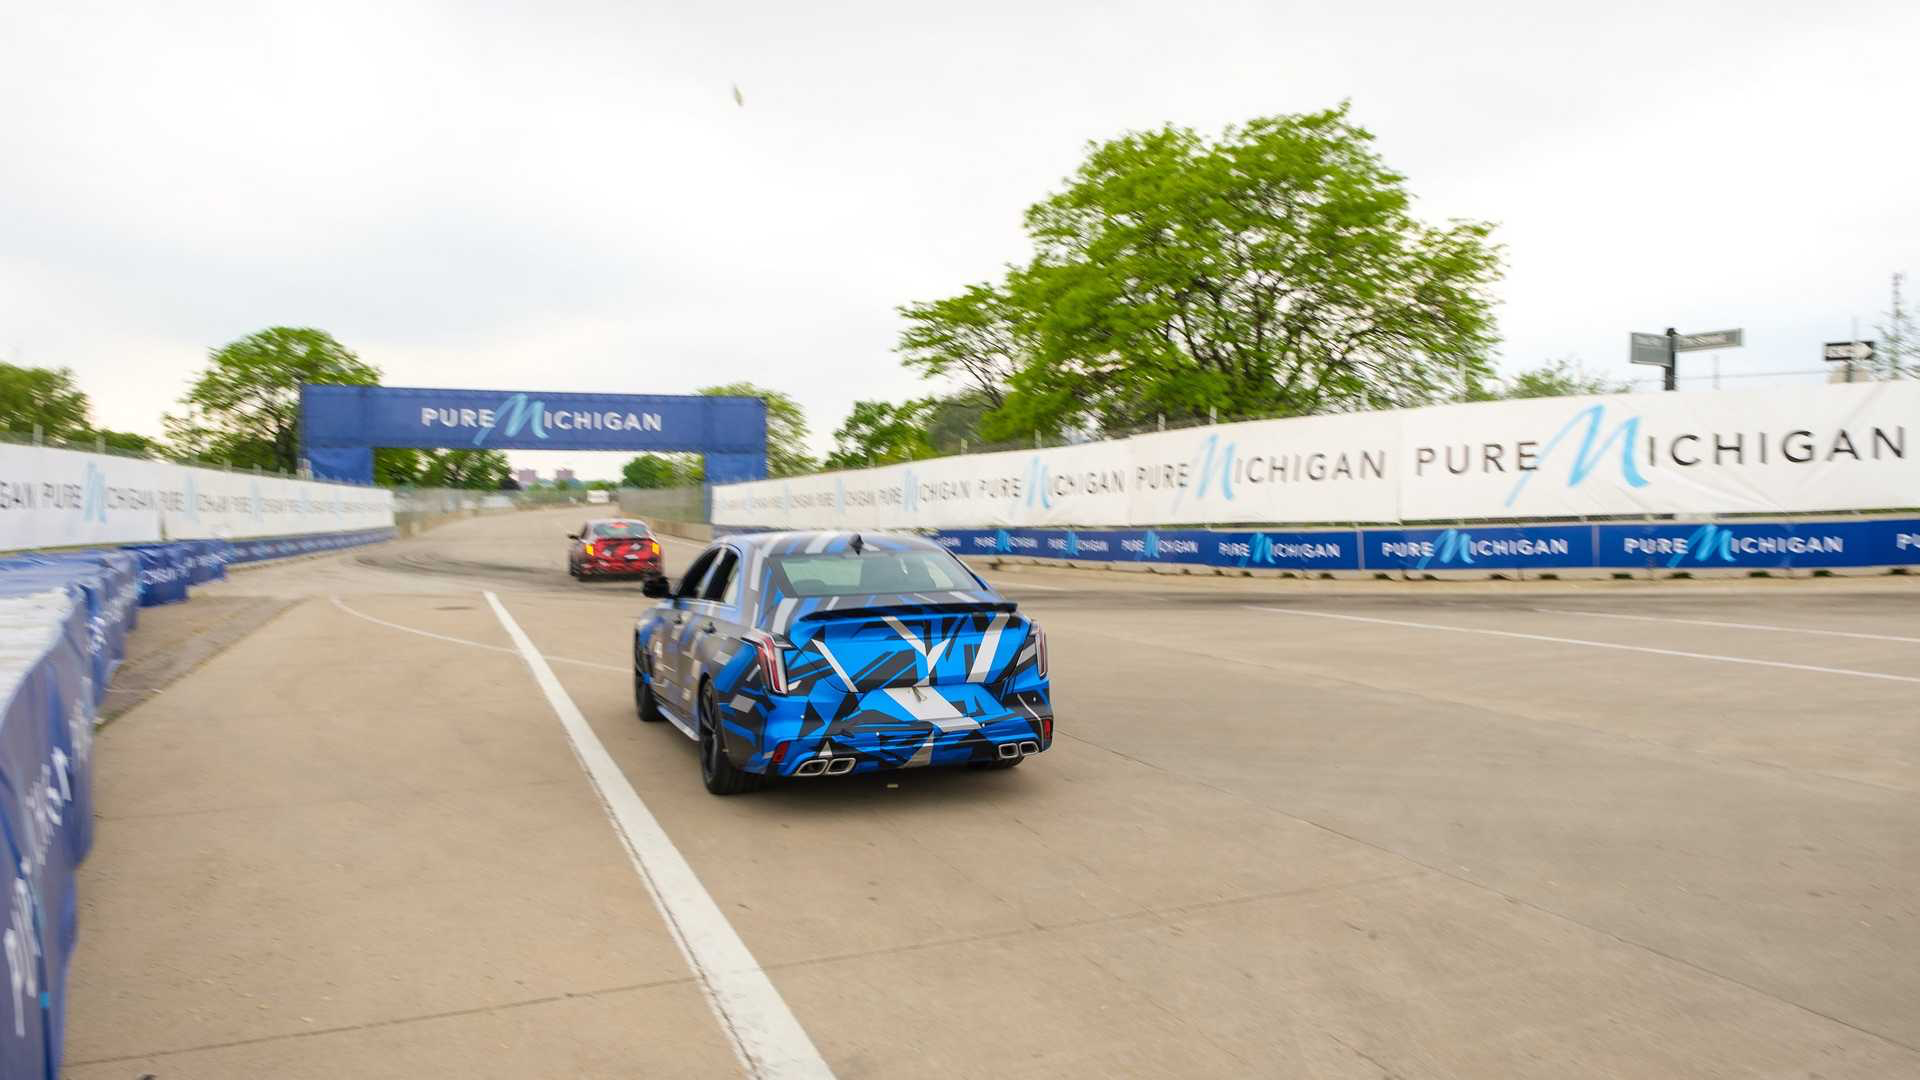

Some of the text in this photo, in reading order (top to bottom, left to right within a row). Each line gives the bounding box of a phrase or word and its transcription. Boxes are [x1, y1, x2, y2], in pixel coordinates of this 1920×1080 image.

[421, 393, 662, 446] PURE MICHIGAN
[1135, 433, 1386, 514] PURE MICHIGAN
[1417, 404, 1906, 507] PURE MICHIGAN
[977, 455, 1126, 514] PURE MICHIGAN
[1219, 531, 1342, 567] PURE MICHIGAN
[1382, 528, 1568, 569] PURE MICHIGAN
[1624, 523, 1844, 567] PURE MICHIGAN
